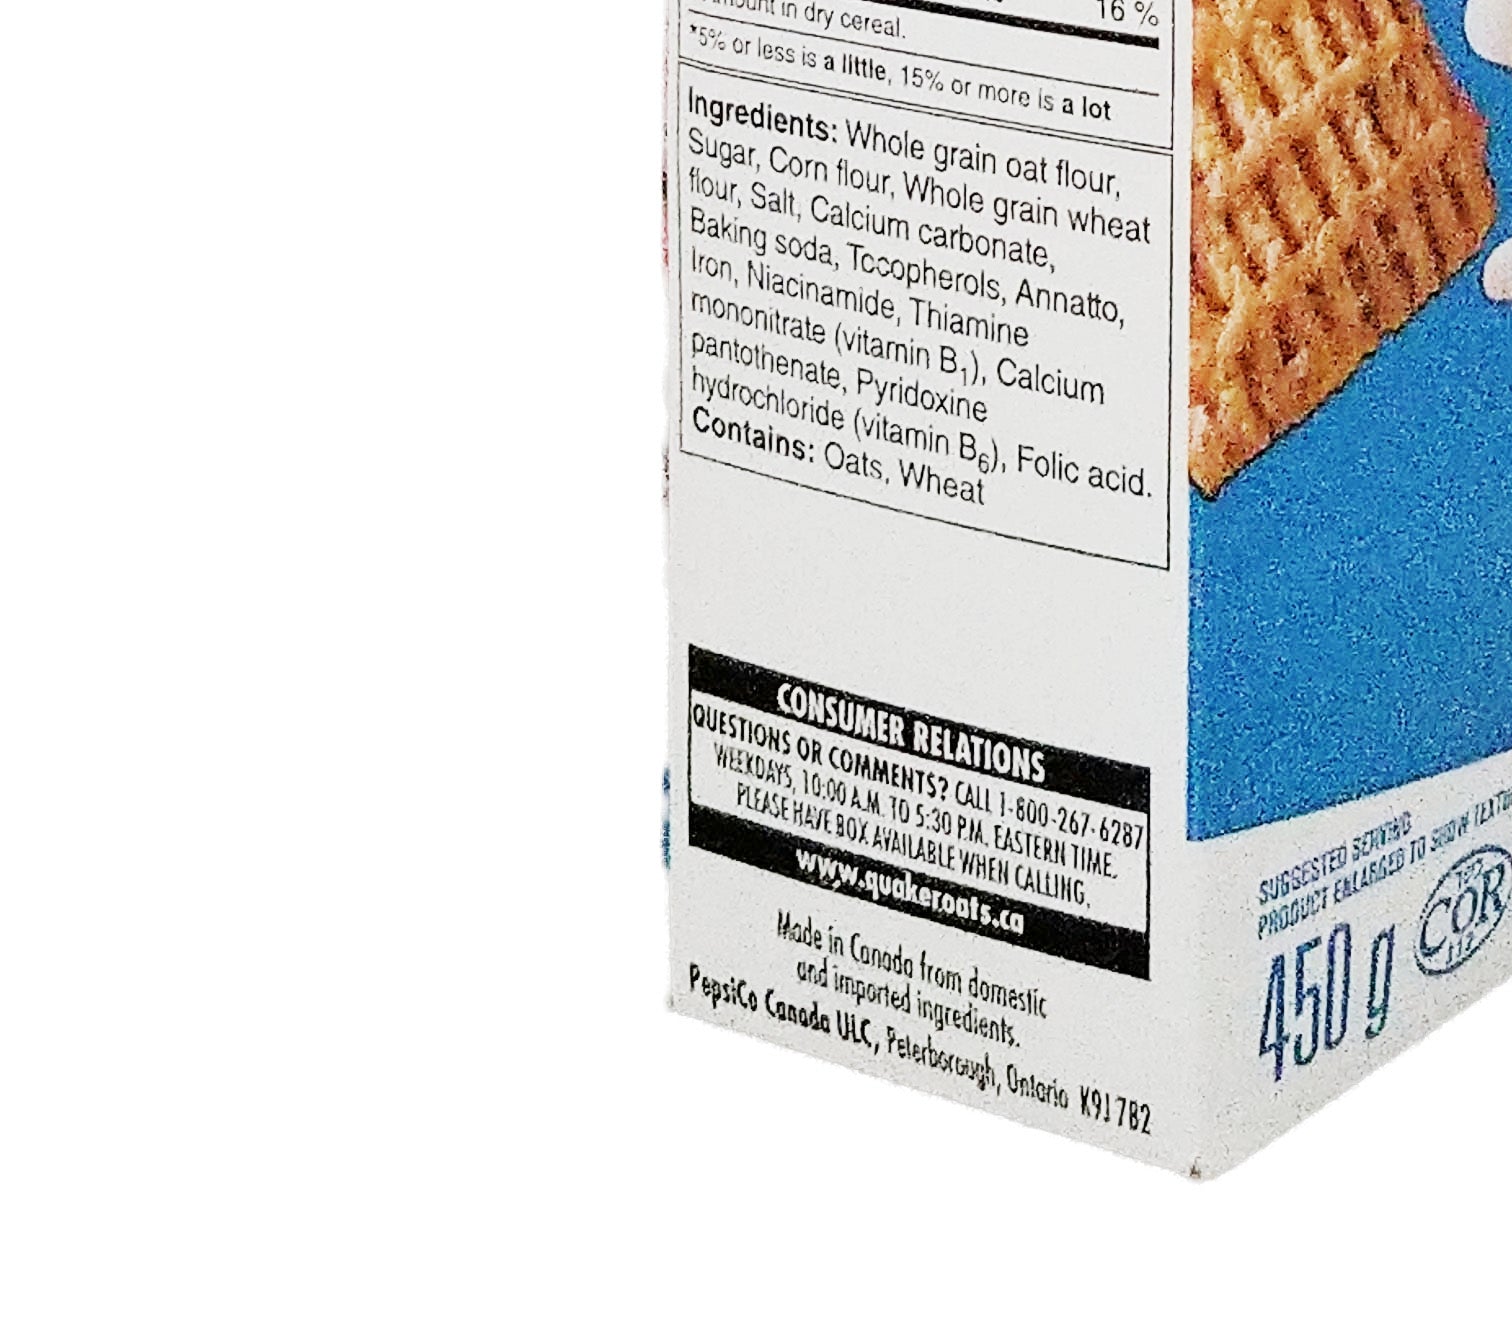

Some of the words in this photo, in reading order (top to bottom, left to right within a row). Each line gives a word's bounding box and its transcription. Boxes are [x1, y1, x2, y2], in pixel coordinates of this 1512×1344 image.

[781, 1, 798, 19] in
[804, 1, 835, 31] dry
[840, 11, 907, 40] cereal.
[688, 86, 838, 144] Ingredients:
[845, 119, 925, 160] Whole
[934, 142, 996, 175] grain
[1006, 157, 1048, 184] oat
[1055, 158, 1120, 199] flour,
[688, 126, 761, 172] Sugar,
[769, 145, 828, 182] Corn
[836, 157, 895, 199] flour,
[902, 170, 984, 214] Whole
[993, 196, 1058, 228] grain
[1067, 205, 1151, 245] wheat
[688, 166, 742, 209] flour,
[750, 181, 802, 220] Salt,
[810, 194, 910, 241] Calcium
[918, 223, 1055, 274] carbonate,
[691, 205, 767, 257] Baking
[775, 234, 839, 271] soda,
[1015, 278, 1124, 330] Annatto,
[691, 291, 826, 345] mononitrate
[834, 321, 930, 370] (vitamin
[996, 357, 1105, 405] Calcium
[692, 245, 738, 289] Iron,
[747, 259, 901, 328] Niacinamide,
[908, 296, 1029, 347] Thiamine
[691, 332, 847, 394] pantothenate,
[857, 367, 988, 423] Pyridoxine
[692, 364, 845, 431] hydrochloride
[853, 407, 949, 456] (vitamin
[1017, 443, 1080, 484] Folic
[1088, 465, 1152, 498] acid.
[692, 405, 814, 463] Contains:
[824, 441, 890, 485] Oats,
[899, 459, 985, 506] Wheat
[692, 703, 791, 755] QUESTIONS
[796, 736, 823, 766] OR
[828, 745, 949, 802] COMMENTS?
[955, 780, 992, 813] CALL
[776, 682, 906, 747] CONSUMER
[913, 720, 1046, 783] RELATIONS
[795, 848, 1024, 935] www.quakeroats.ca
[777, 911, 823, 951] Made
[828, 925, 844, 957] in
[849, 932, 914, 979] Canada
[919, 949, 962, 995] from
[968, 966, 1047, 1020] domestic
[796, 956, 828, 988] and
[834, 972, 911, 1014] imported
[917, 989, 1020, 1048] ingredients.
[1258, 921, 1353, 1083] 450
[1364, 921, 1397, 1041] g
[689, 962, 758, 1012] PepsiCo
[764, 988, 831, 1035] Canada
[836, 1009, 880, 1056] ULC,
[886, 1025, 1001, 1097] Peterborough,
[1006, 1063, 1069, 1109] Ontario
